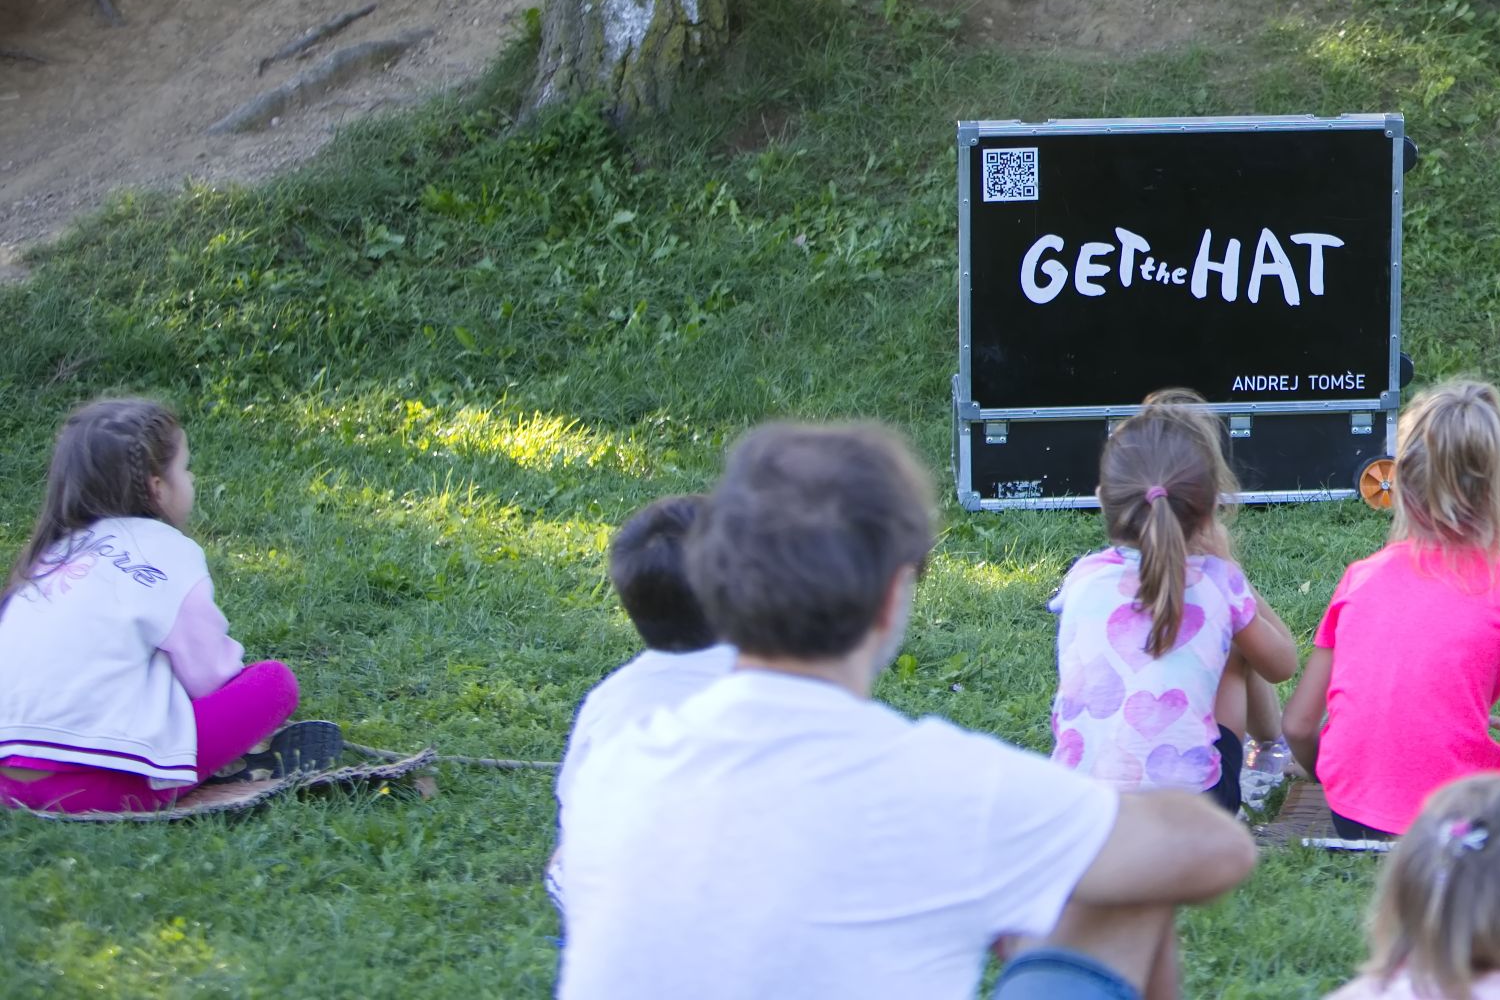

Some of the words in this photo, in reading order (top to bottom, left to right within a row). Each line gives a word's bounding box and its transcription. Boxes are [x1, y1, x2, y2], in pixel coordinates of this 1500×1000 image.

[1020, 227, 1151, 304] GET
[1139, 256, 1188, 285] the
[1190, 227, 1345, 307] HAT
[1232, 375, 1299, 391] ANDREJ
